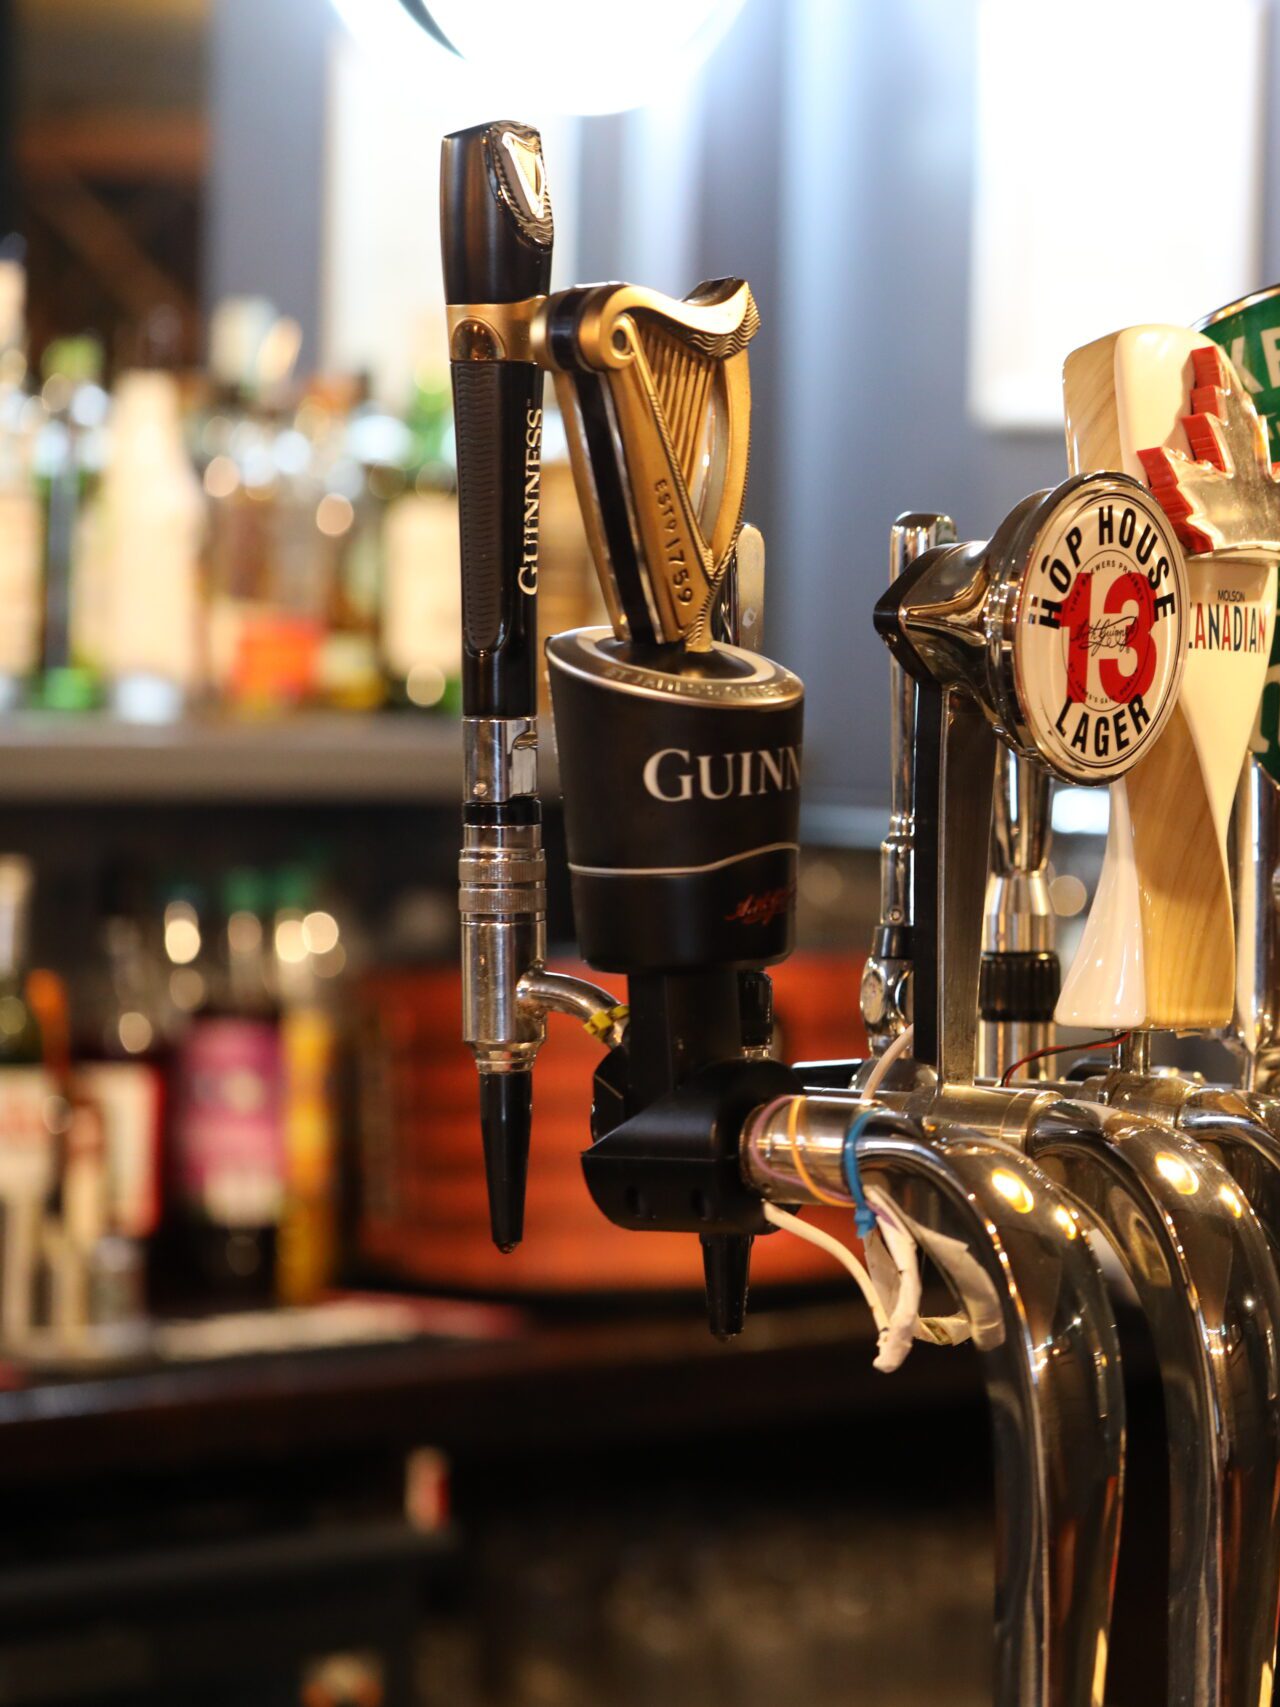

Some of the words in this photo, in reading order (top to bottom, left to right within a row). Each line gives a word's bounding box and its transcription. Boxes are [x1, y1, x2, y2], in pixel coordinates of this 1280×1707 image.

[517, 408, 542, 597] GUINNESS
[664, 537, 694, 606] 1759
[1037, 526, 1082, 630] HOP
[1098, 504, 1176, 623] HOUSE
[1217, 589, 1246, 602] MOLSON
[1055, 572, 1158, 704] 13
[1055, 693, 1151, 757] LAGER
